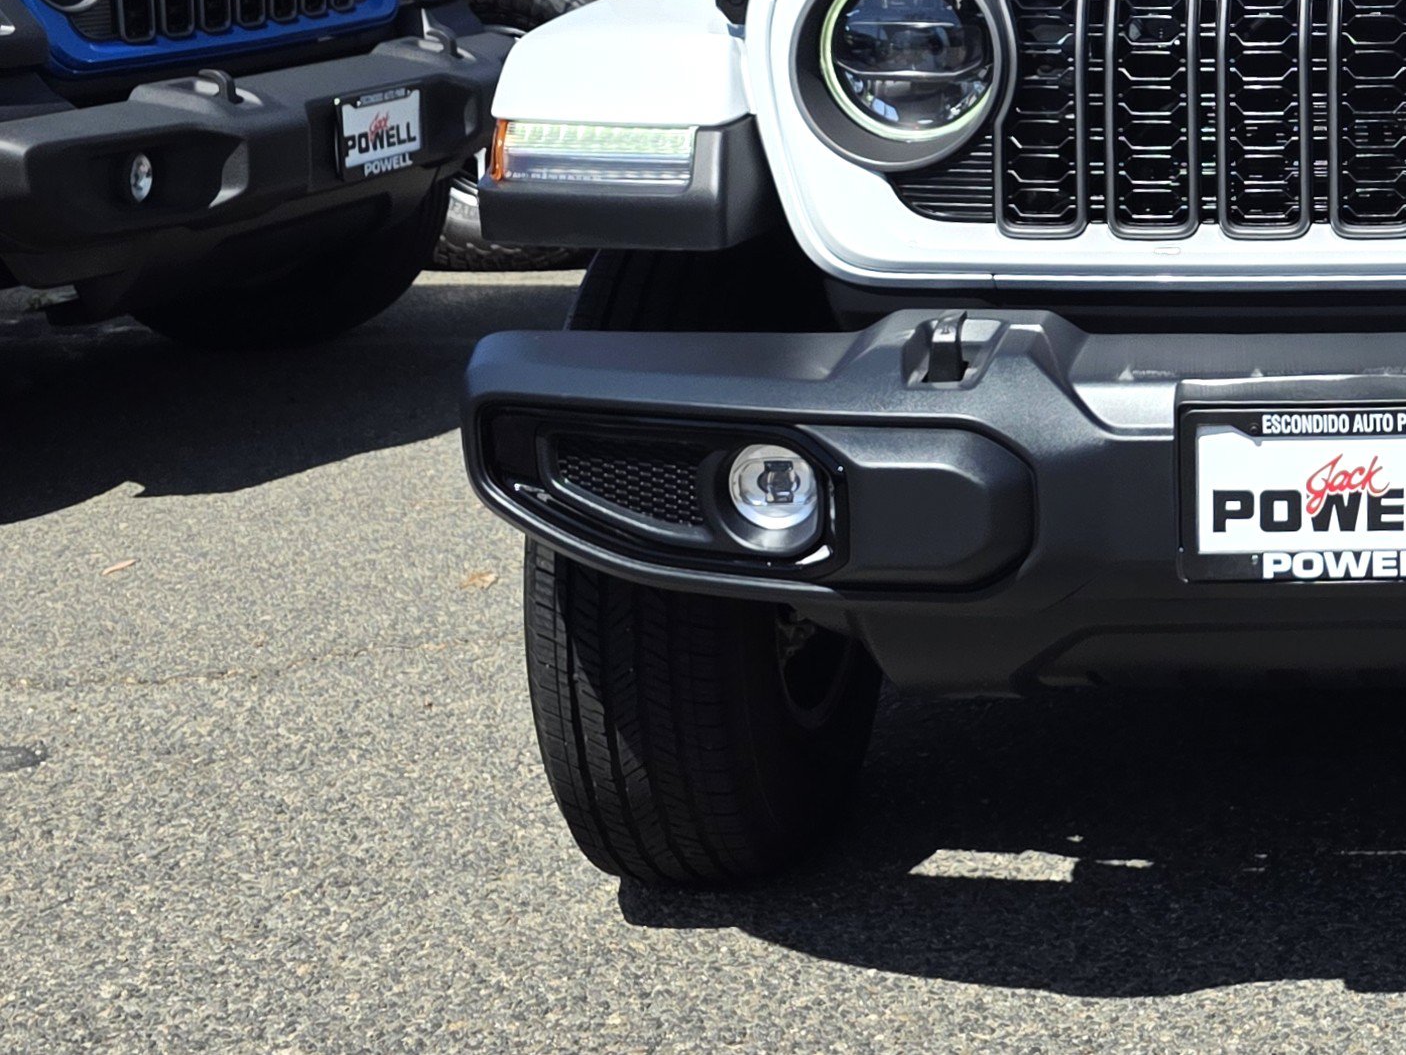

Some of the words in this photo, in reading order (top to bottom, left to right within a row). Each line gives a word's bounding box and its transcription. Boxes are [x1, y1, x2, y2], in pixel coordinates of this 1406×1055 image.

[344, 121, 417, 157] POWELL
[364, 152, 413, 177] POWELL
[1262, 413, 1350, 435] ESCONDIDO
[1353, 412, 1394, 433] AUTO
[1306, 453, 1390, 515] Jack
